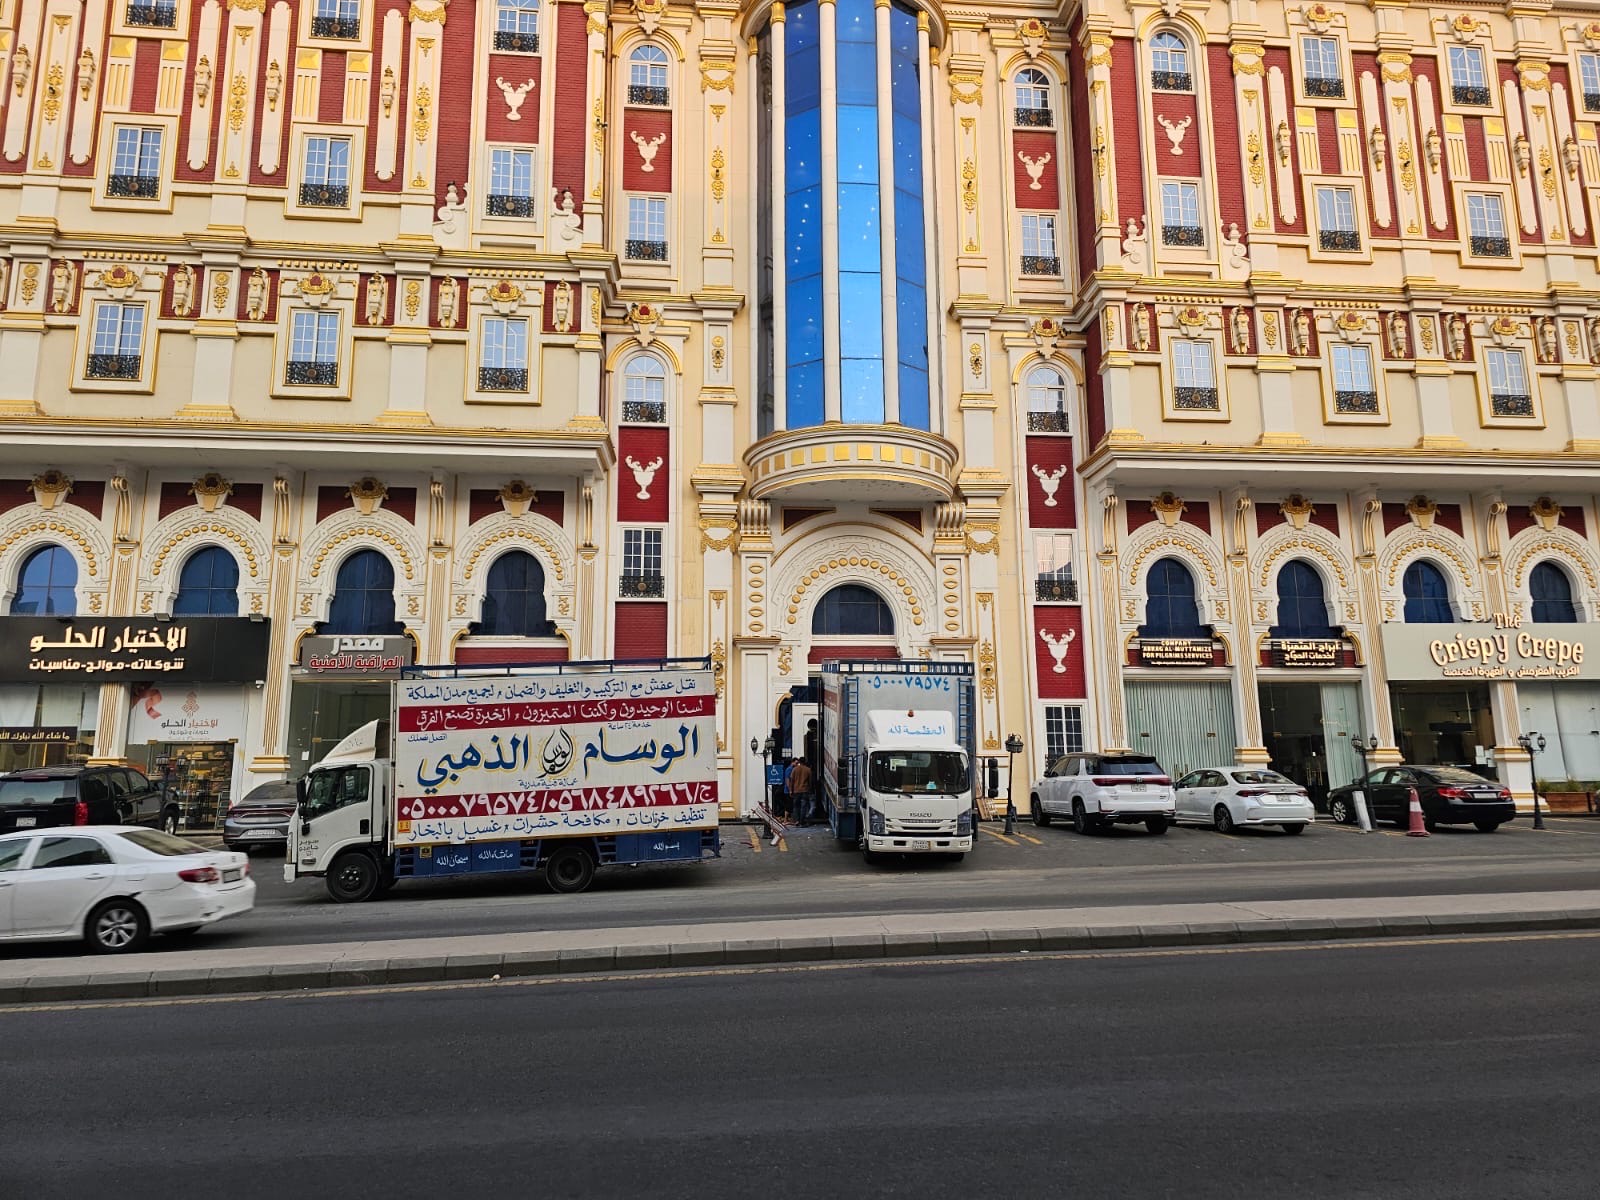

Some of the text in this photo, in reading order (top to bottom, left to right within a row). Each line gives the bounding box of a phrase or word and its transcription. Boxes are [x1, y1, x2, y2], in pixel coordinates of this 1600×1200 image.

[1493, 612, 1522, 629] The
[30, 626, 187, 653] الاختيار الحلو
[330, 638, 384, 655] مصدر
[1430, 631, 1584, 666] Crispy Crepe
[309, 652, 404, 672] المراقبة الأمنية
[1479, 666, 1505, 678] القهوة
[549, 680, 591, 698] والتغليف
[593, 678, 628, 697] التركيب
[630, 683, 643, 697] مع
[644, 678, 674, 695] عفش
[675, 677, 696, 694] نقل
[867, 675, 950, 691] ٠٥٠٠٠٧٩٥٧٤
[406, 685, 443, 700] المملكة
[442, 686, 467, 701] مدن
[467, 684, 494, 704] لجميع
[580, 700, 617, 720] ولكننا
[619, 700, 673, 718] الوحيدون
[676, 697, 704, 714] لسنا
[416, 709, 443, 731] الفرق
[444, 707, 475, 730] تصنع
[473, 705, 511, 725] الخبرة
[584, 723, 699, 779] الوسام
[417, 733, 530, 794] الذهبي
[513, 815, 559, 834] حشرات
[561, 812, 611, 827] مكافحة
[626, 811, 669, 828] خزانات
[674, 808, 707, 825] تنظيف
[408, 820, 453, 842] بالبخار
[457, 820, 501, 841] غسيل
